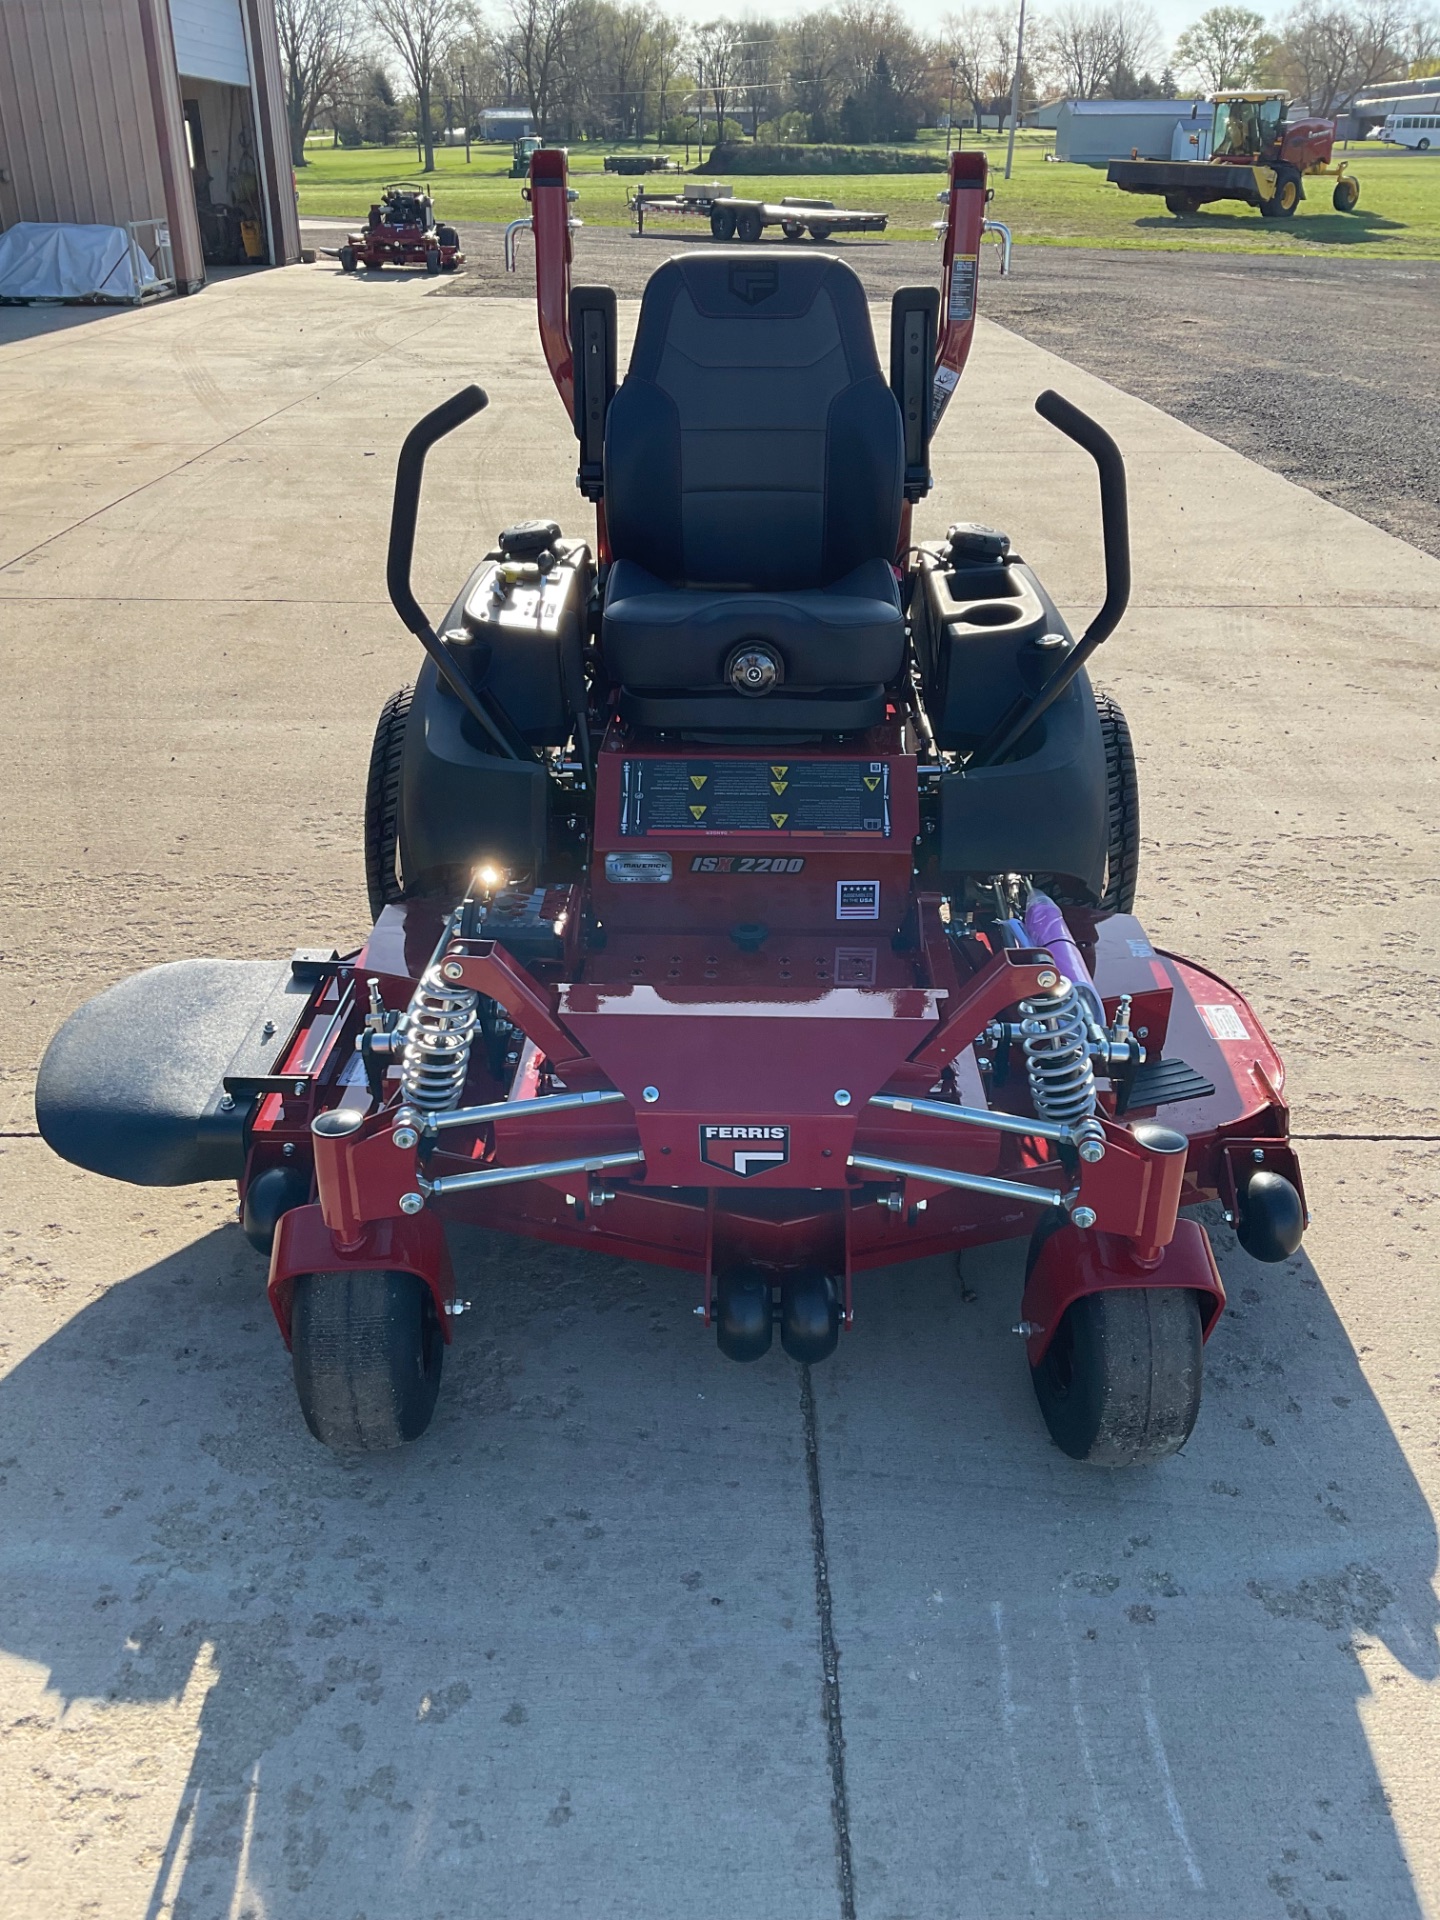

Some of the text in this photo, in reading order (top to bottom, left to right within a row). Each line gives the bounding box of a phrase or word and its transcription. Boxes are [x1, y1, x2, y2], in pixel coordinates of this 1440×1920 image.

[691, 857, 804, 873] ISX 2200
[705, 1127, 785, 1139] FERRIS
